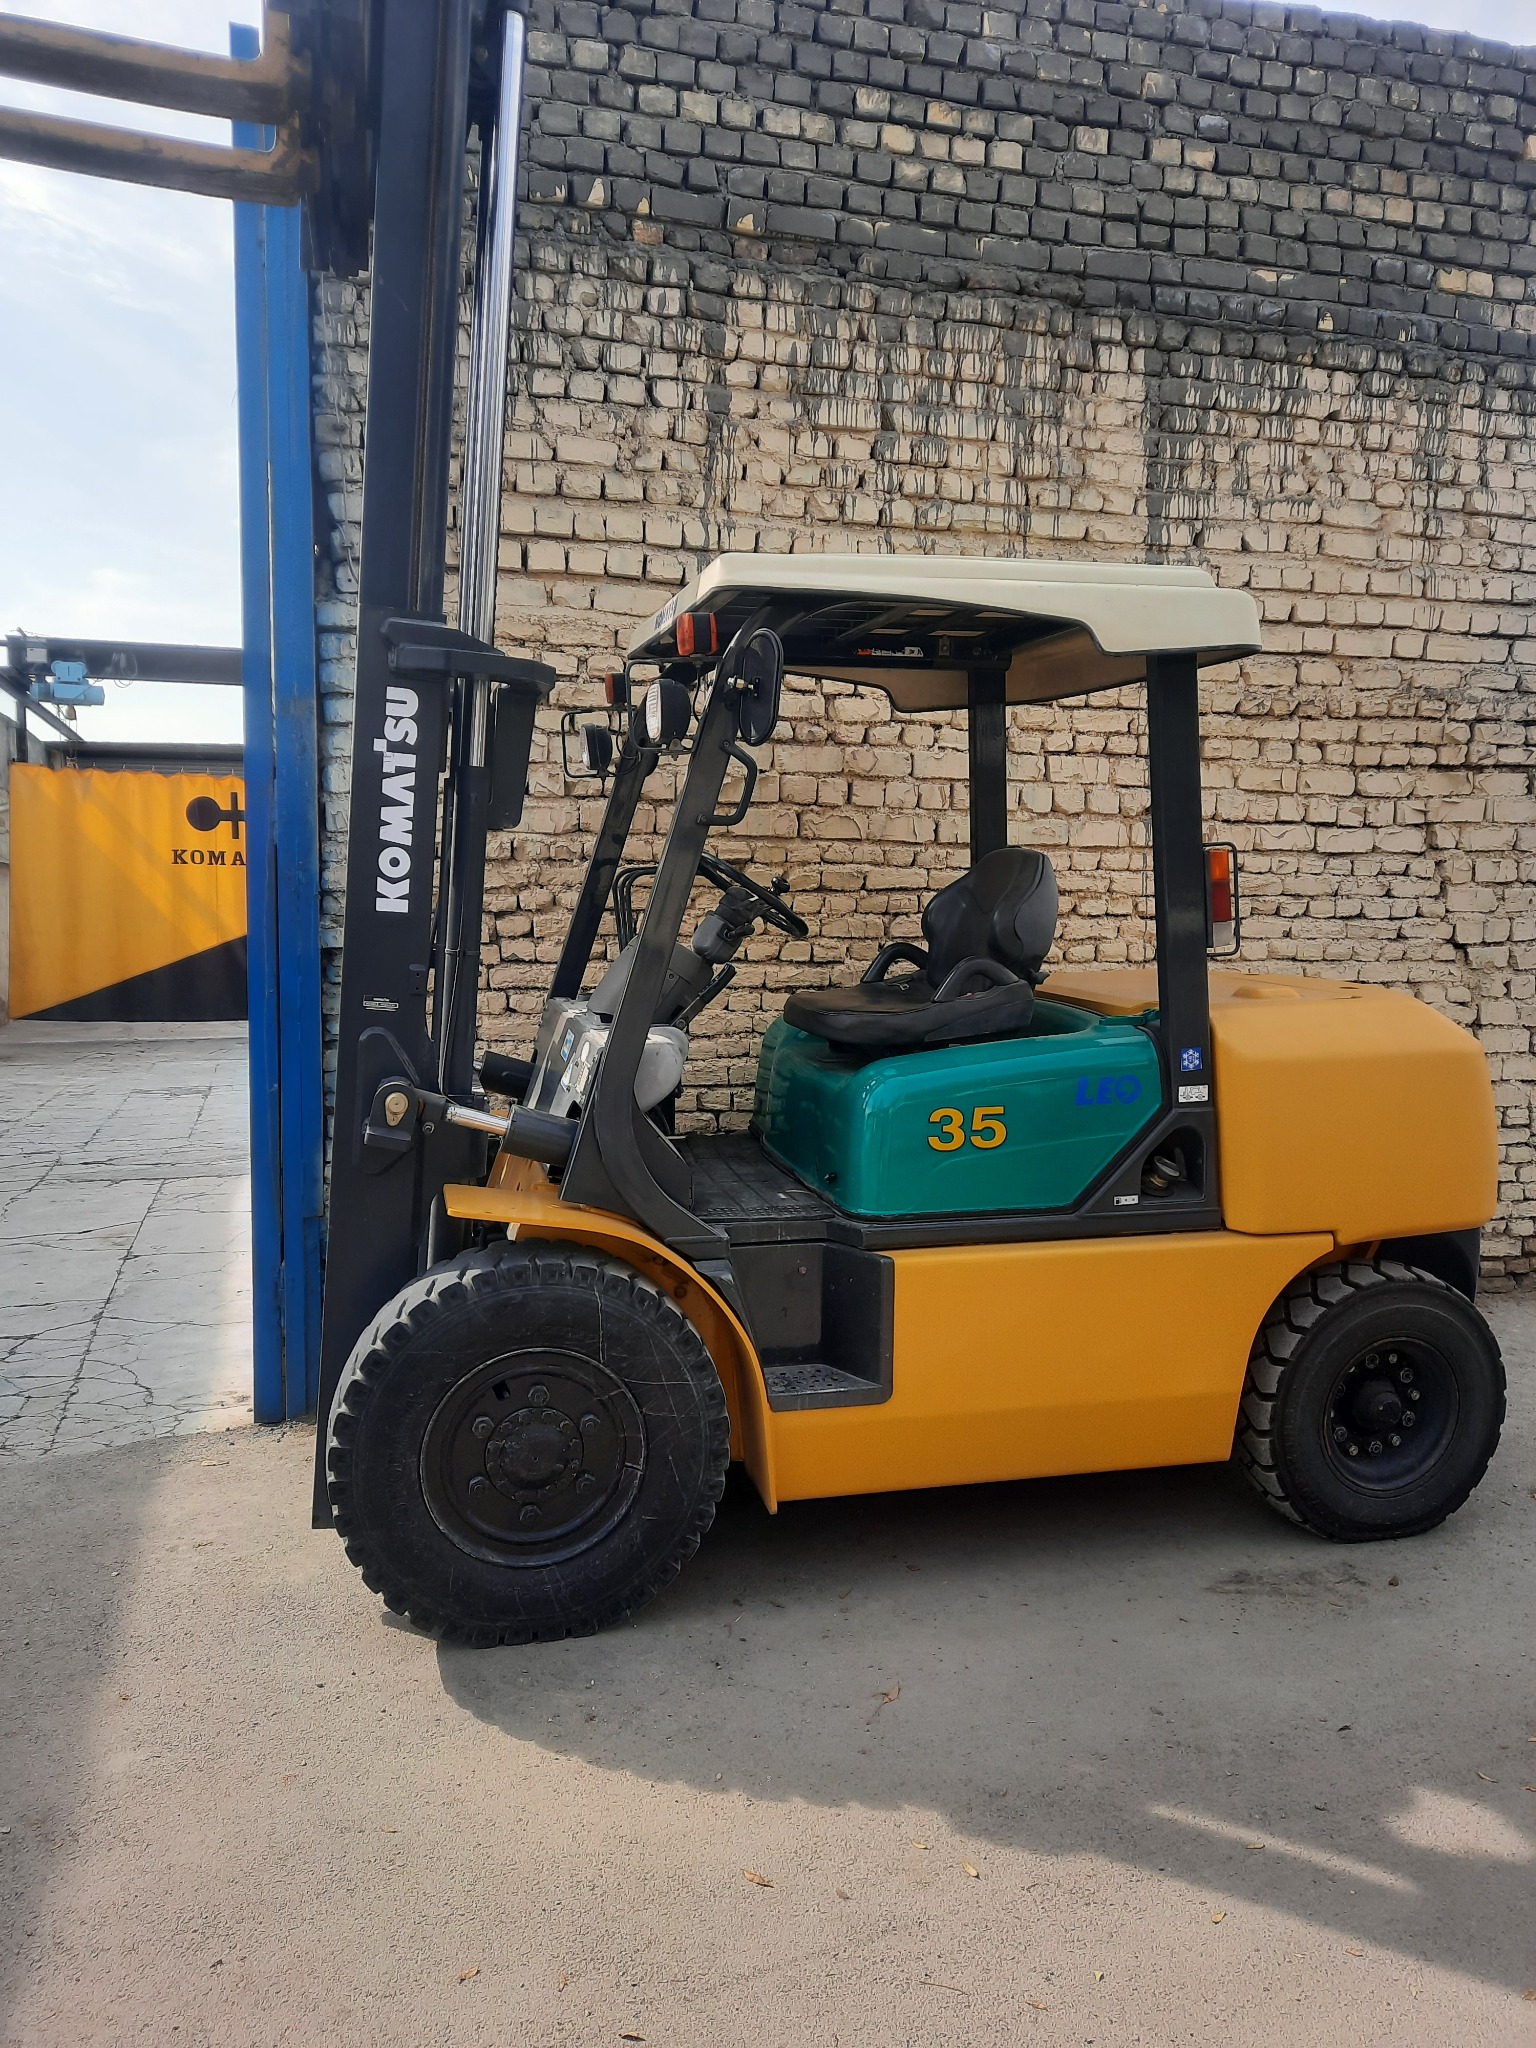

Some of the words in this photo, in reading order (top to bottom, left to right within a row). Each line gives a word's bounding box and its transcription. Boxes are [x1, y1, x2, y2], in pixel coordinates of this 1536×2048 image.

[373, 686, 419, 913] KOMATSU
[171, 849, 246, 866] KOMA
[1075, 1075, 1142, 1106] LEO
[927, 1106, 1007, 1151] 35
